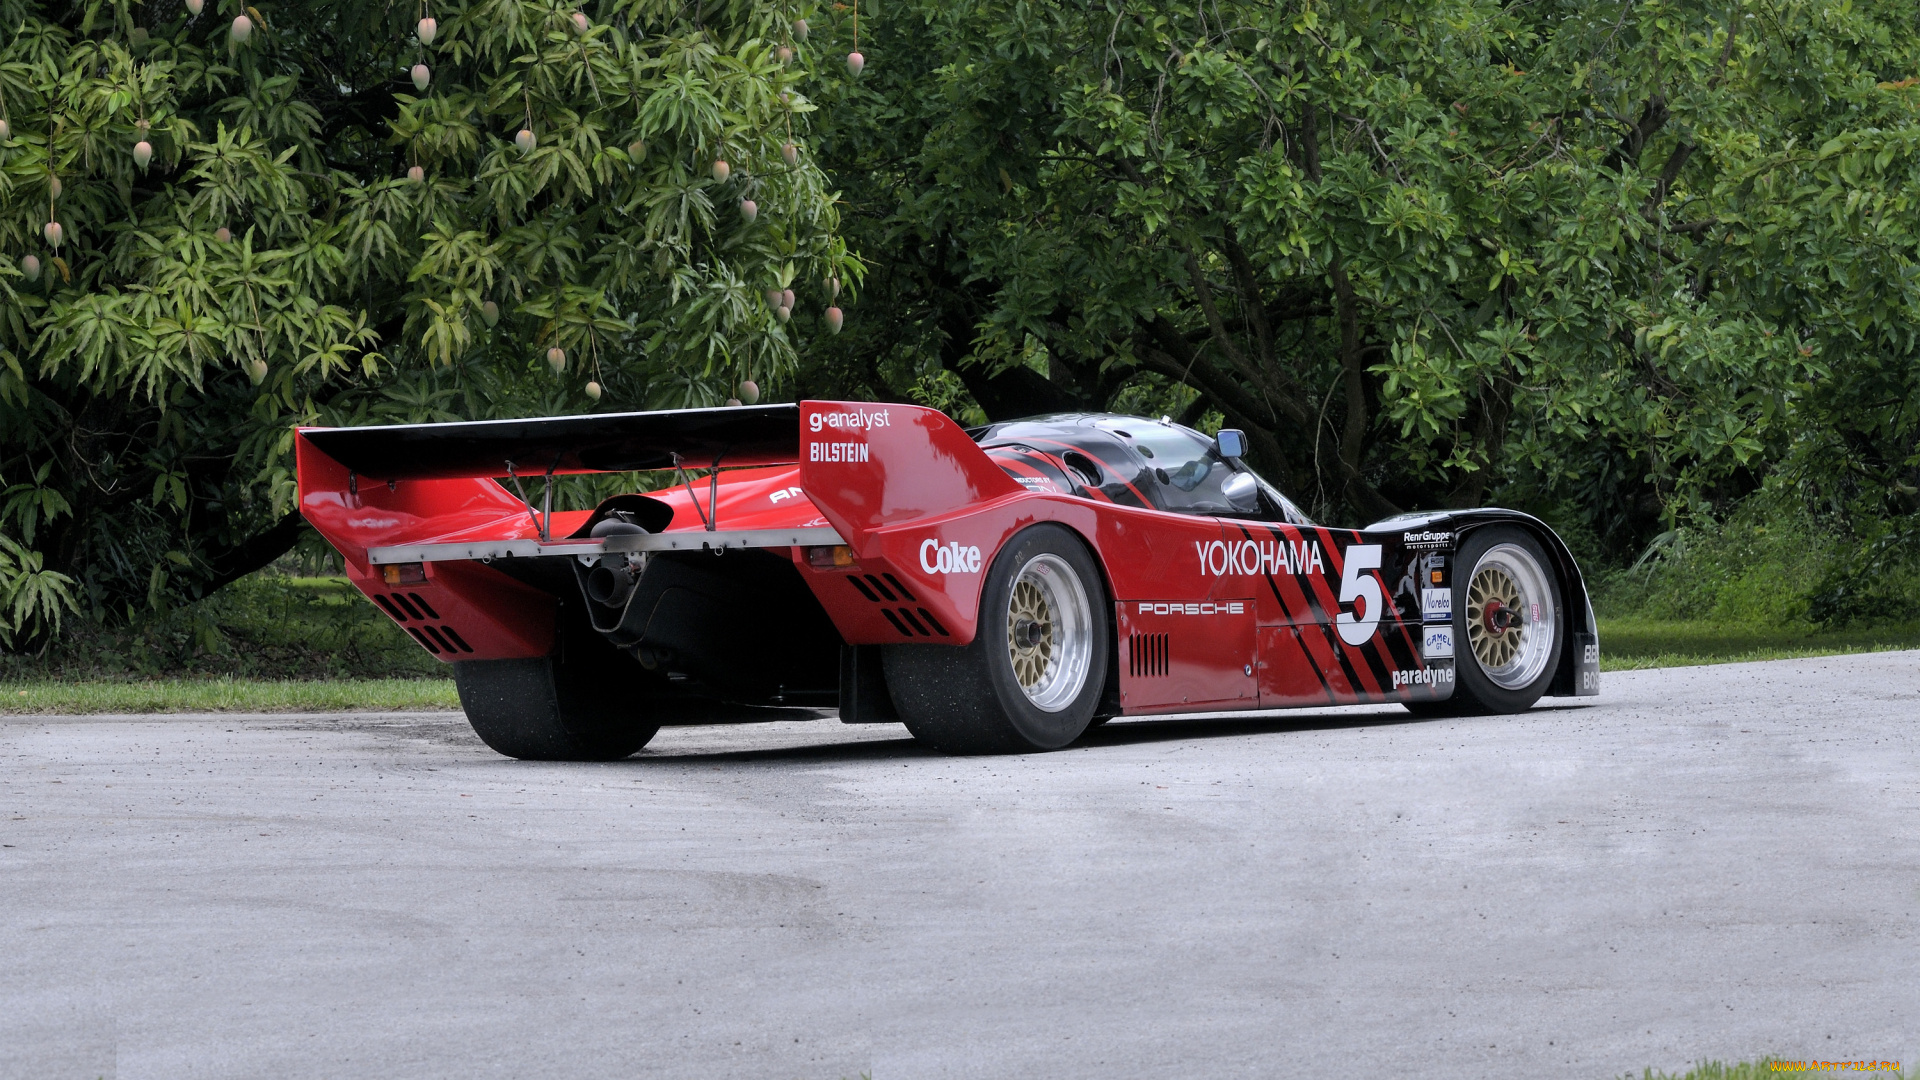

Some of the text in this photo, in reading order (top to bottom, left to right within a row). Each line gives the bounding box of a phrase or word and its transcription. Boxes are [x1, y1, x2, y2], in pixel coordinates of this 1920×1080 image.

[810, 442, 869, 463] BILSTEIN
[919, 539, 981, 574] Coke
[1196, 540, 1325, 575] YOKOHAMA
[1336, 544, 1383, 646] 5
[1424, 590, 1450, 612] Norelco
[1138, 602, 1244, 615] PORSCHE
[1426, 633, 1452, 647] CAMEL
[1435, 642, 1443, 650] GT
[1392, 665, 1453, 689] paradyne
